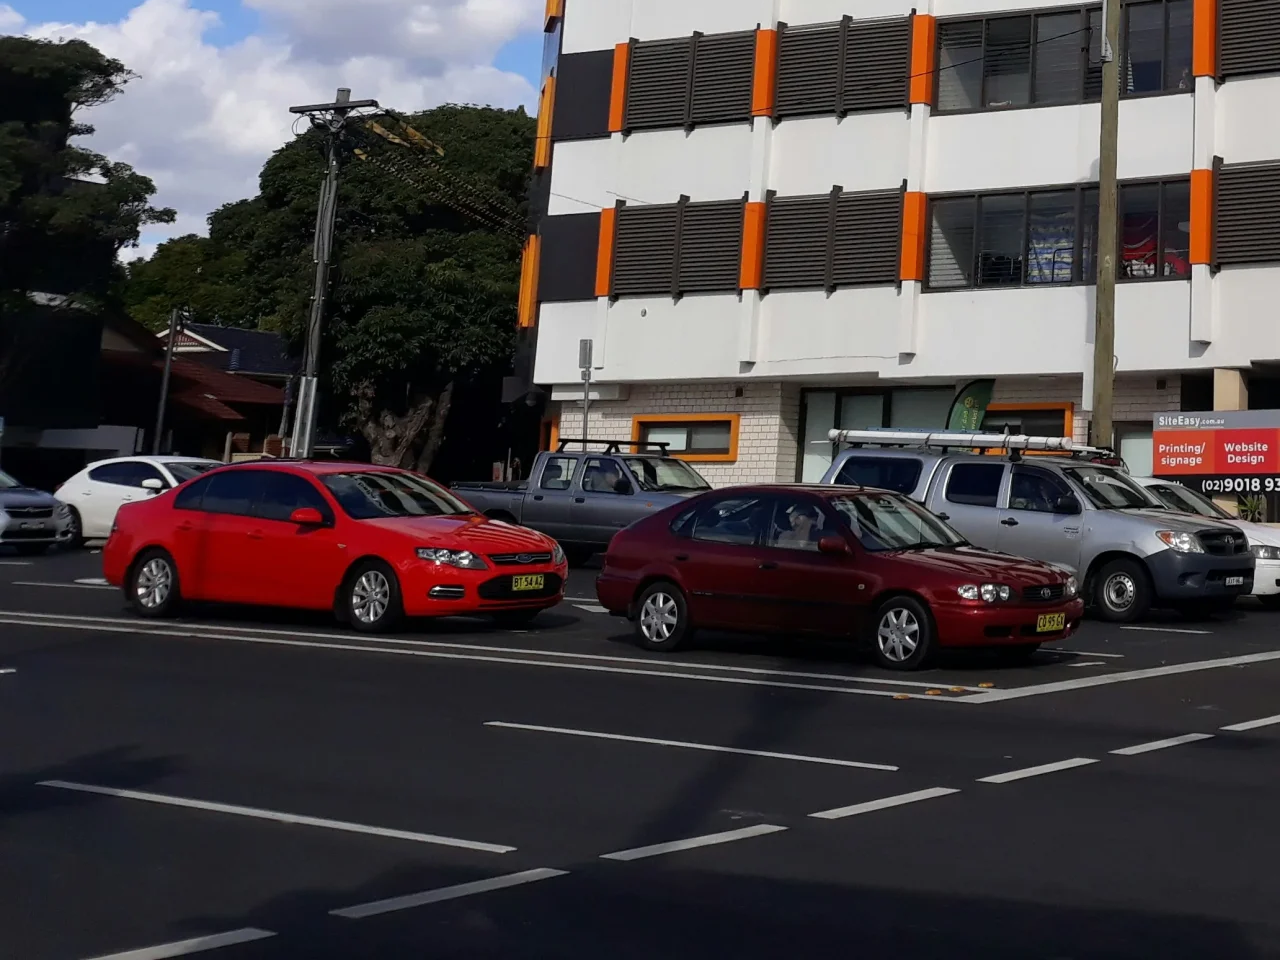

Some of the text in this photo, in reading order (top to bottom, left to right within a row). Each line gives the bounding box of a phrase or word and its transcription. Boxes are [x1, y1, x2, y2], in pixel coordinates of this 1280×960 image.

[1159, 415, 1225, 428] SiteEasy.com.au
[1159, 442, 1206, 455] Printing/
[1224, 442, 1269, 452] Website
[1161, 455, 1203, 467] signage
[1227, 453, 1265, 465] Design
